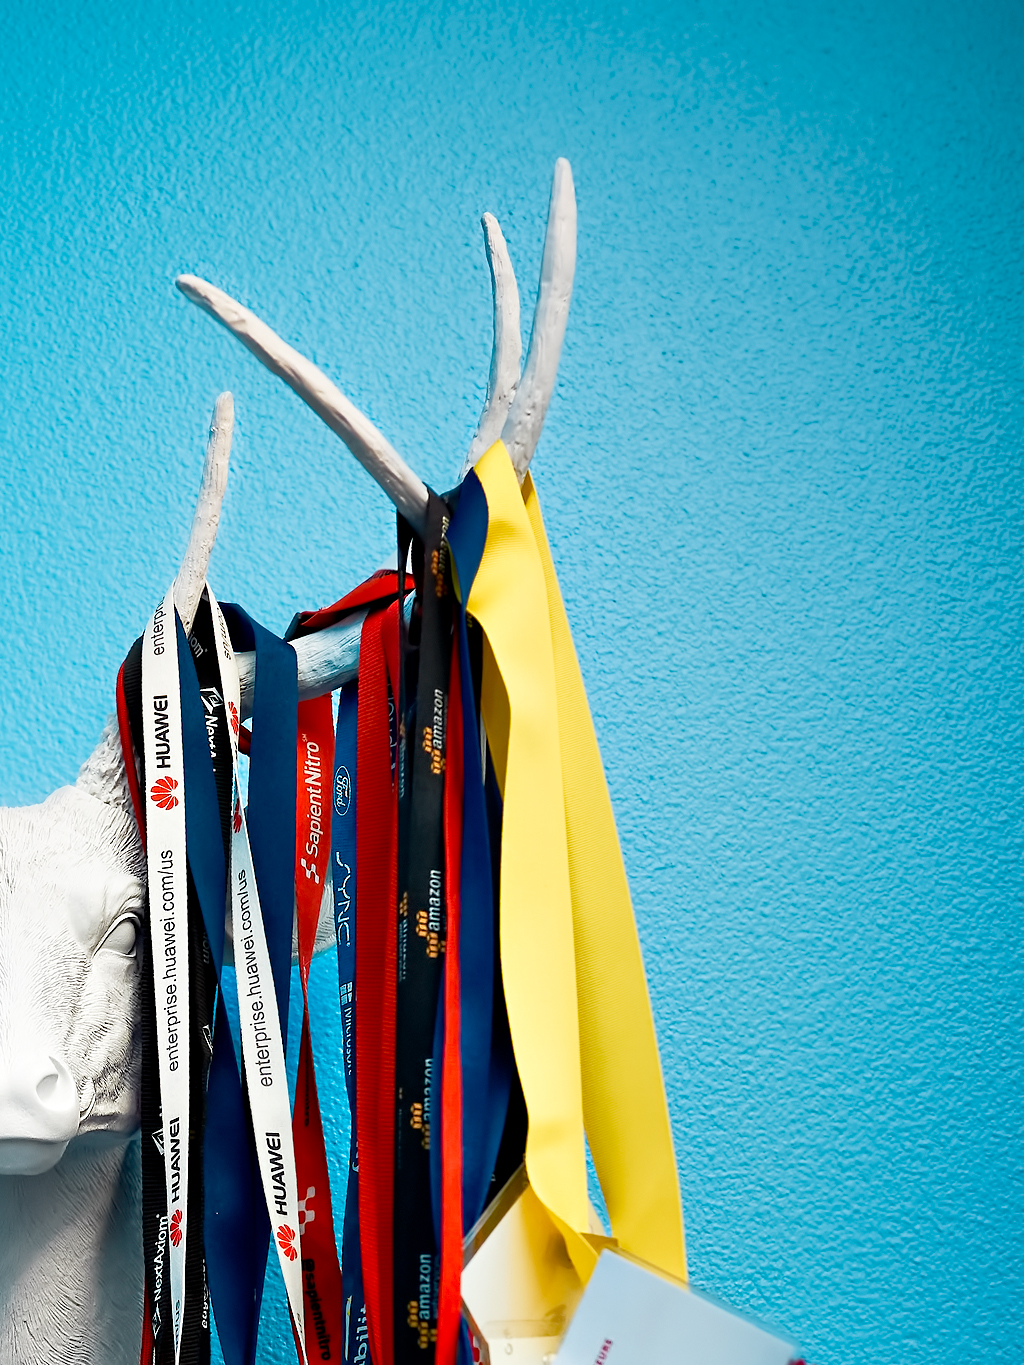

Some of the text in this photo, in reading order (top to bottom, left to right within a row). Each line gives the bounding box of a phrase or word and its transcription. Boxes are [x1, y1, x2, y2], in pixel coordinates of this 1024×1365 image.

[154, 695, 171, 769] HUAWEI
[432, 688, 443, 749] amazon
[336, 852, 351, 947] SYNC
[428, 869, 441, 931] amazon
[161, 849, 179, 1073] enterprise.huawei.com/us
[237, 869, 273, 1088] enterprise.huawei.com/us
[170, 1116, 180, 1204] HUAWEI
[265, 1131, 288, 1216] HUAWEI
[153, 1214, 169, 1302] NextAxiom
[419, 1254, 432, 1321] amazon
